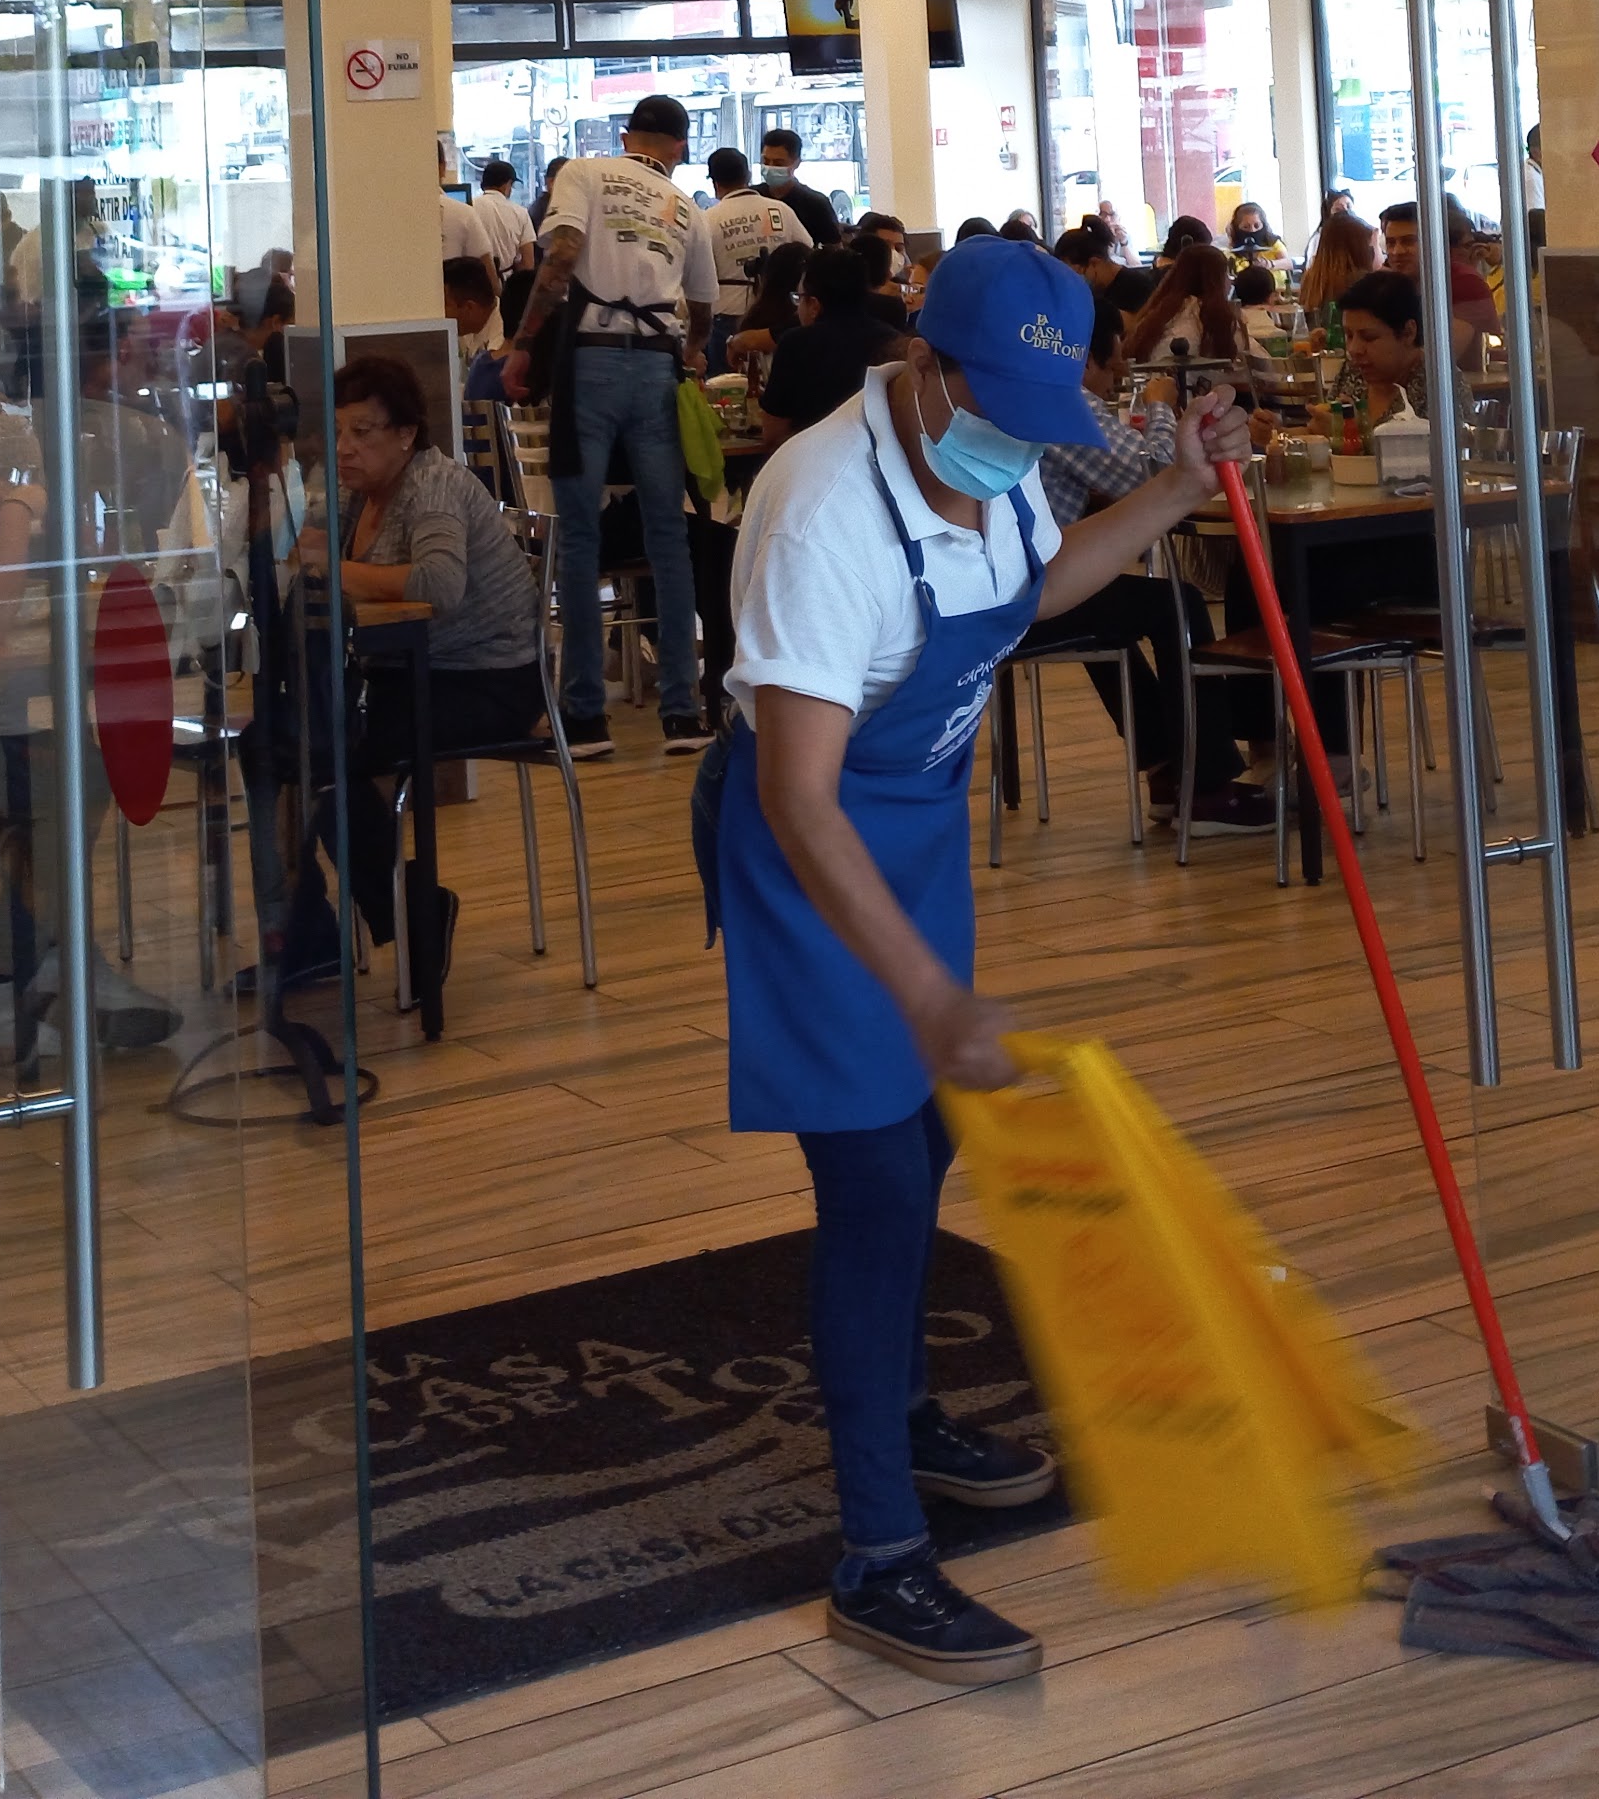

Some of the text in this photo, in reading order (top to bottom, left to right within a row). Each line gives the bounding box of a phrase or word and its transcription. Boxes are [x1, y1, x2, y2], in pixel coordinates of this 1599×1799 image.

[603, 185, 652, 208] APP DE
[646, 187, 663, 199] LA
[603, 205, 618, 215] LA
[622, 204, 647, 222] CASA
[750, 214, 761, 223] LA
[723, 224, 754, 239] APP DE
[725, 242, 736, 251] LA
[737, 237, 755, 248] CASA
[1036, 314, 1049, 325] LA
[1020, 323, 1063, 343] CASA
[1033, 336, 1050, 349] DE
[580, 1309, 993, 1424] TOO
[292, 1338, 670, 1456] CASA
